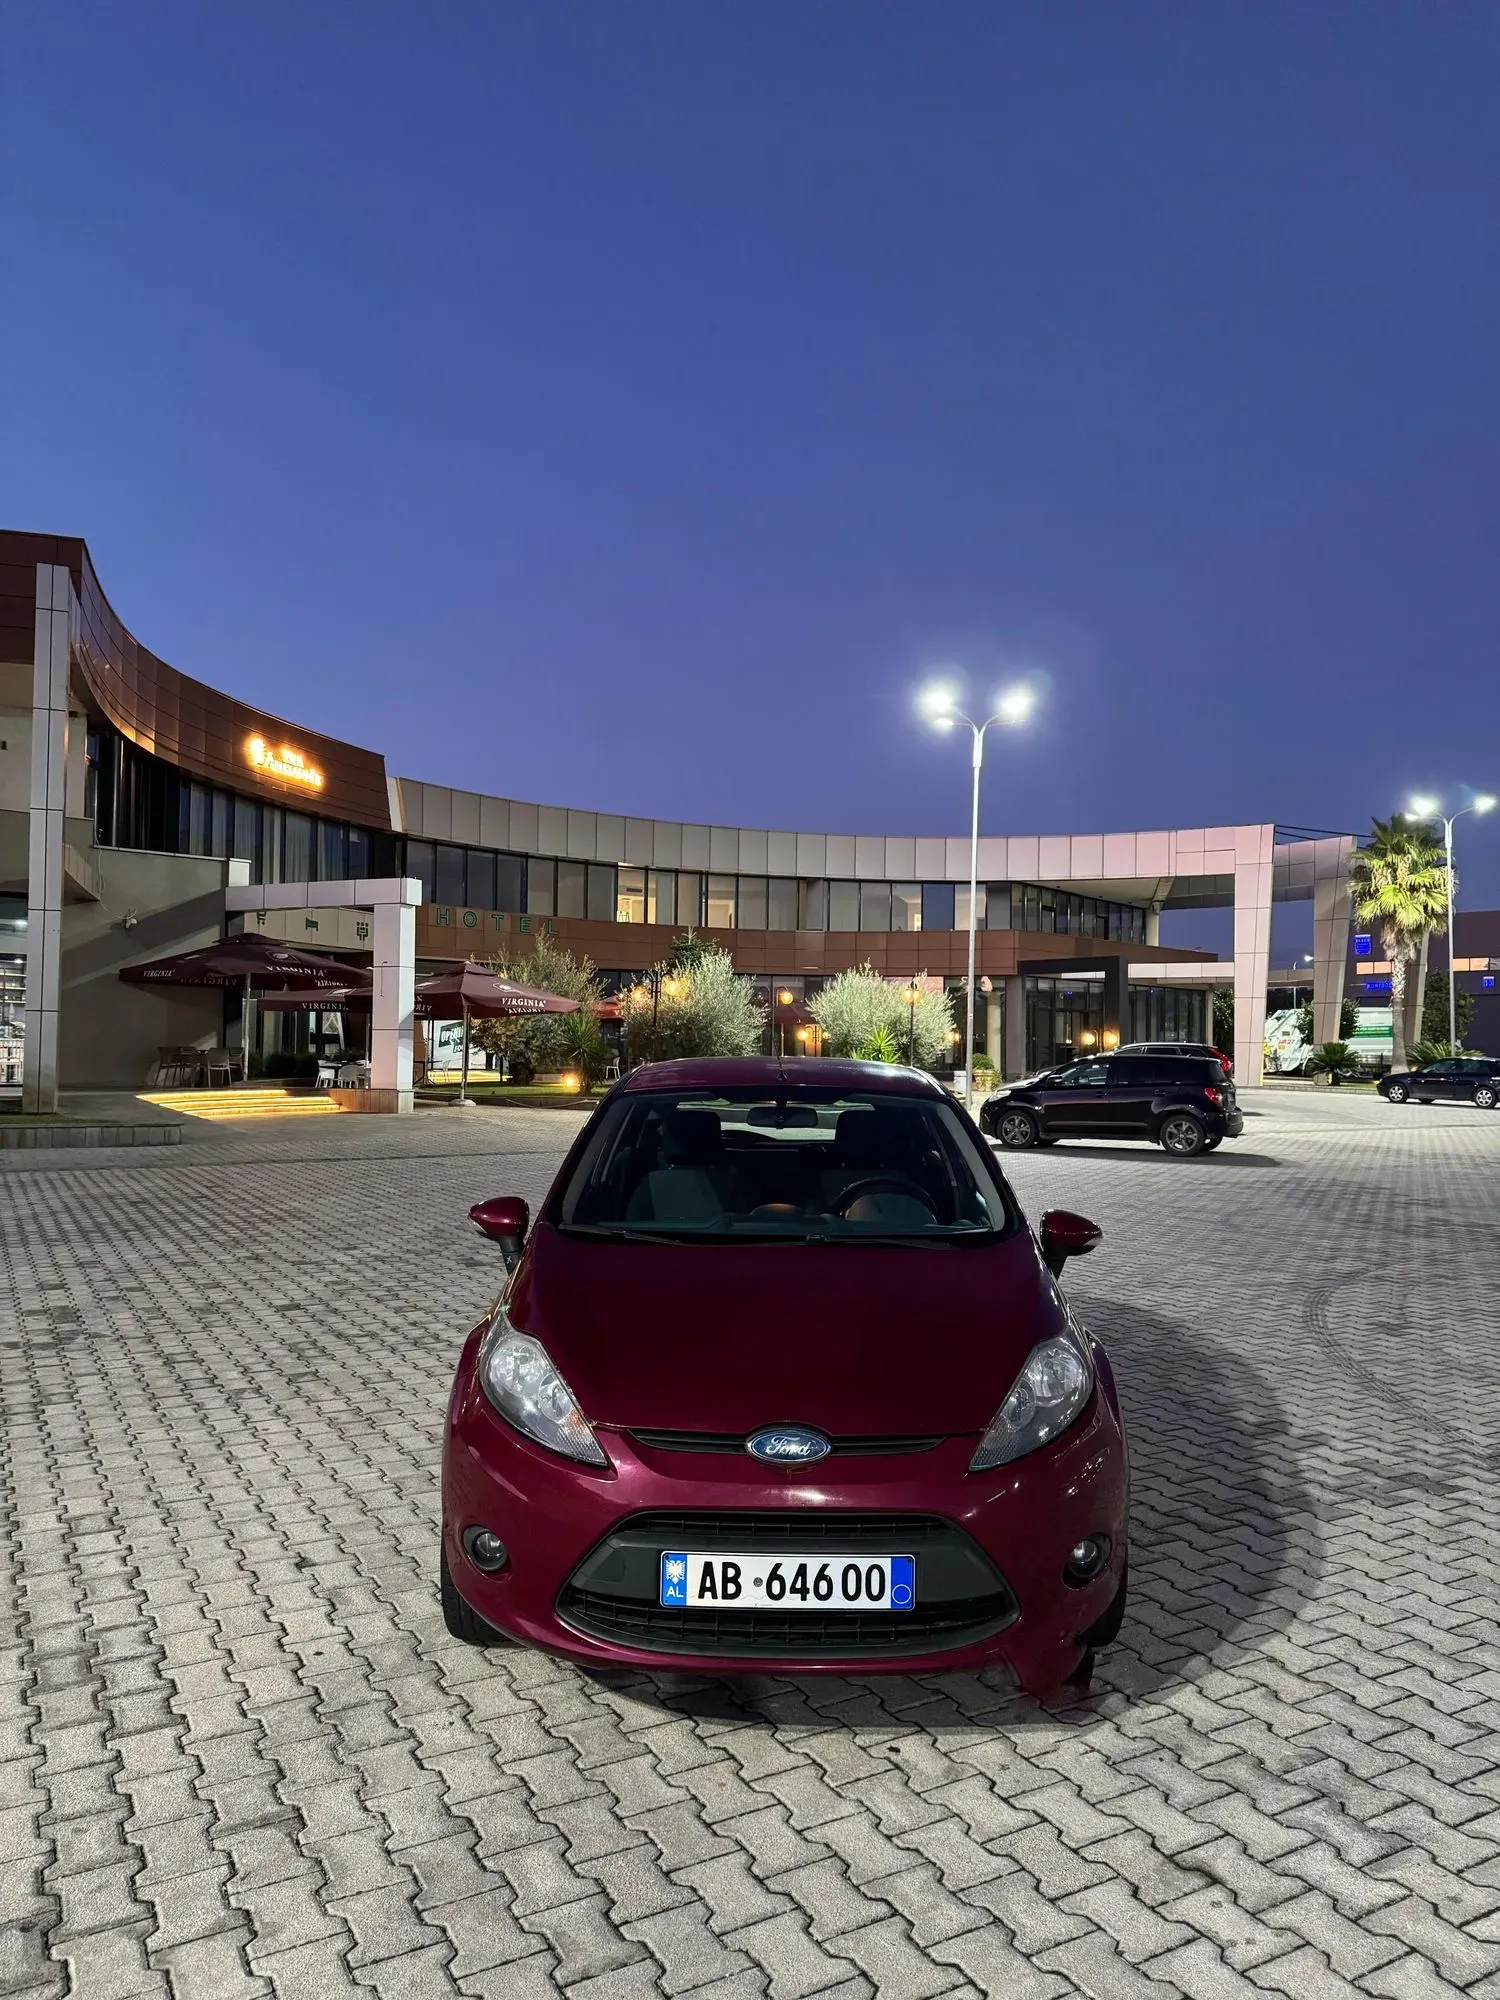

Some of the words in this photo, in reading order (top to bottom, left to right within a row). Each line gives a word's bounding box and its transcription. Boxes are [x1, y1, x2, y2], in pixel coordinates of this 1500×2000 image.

[436, 907, 559, 935] HOTEL
[143, 969, 173, 978] VIRGINIA
[502, 997, 545, 1008] VIRGINIA
[765, 1435, 812, 1456] Ford
[698, 1561, 742, 1600] AB
[666, 1585, 684, 1598] AL
